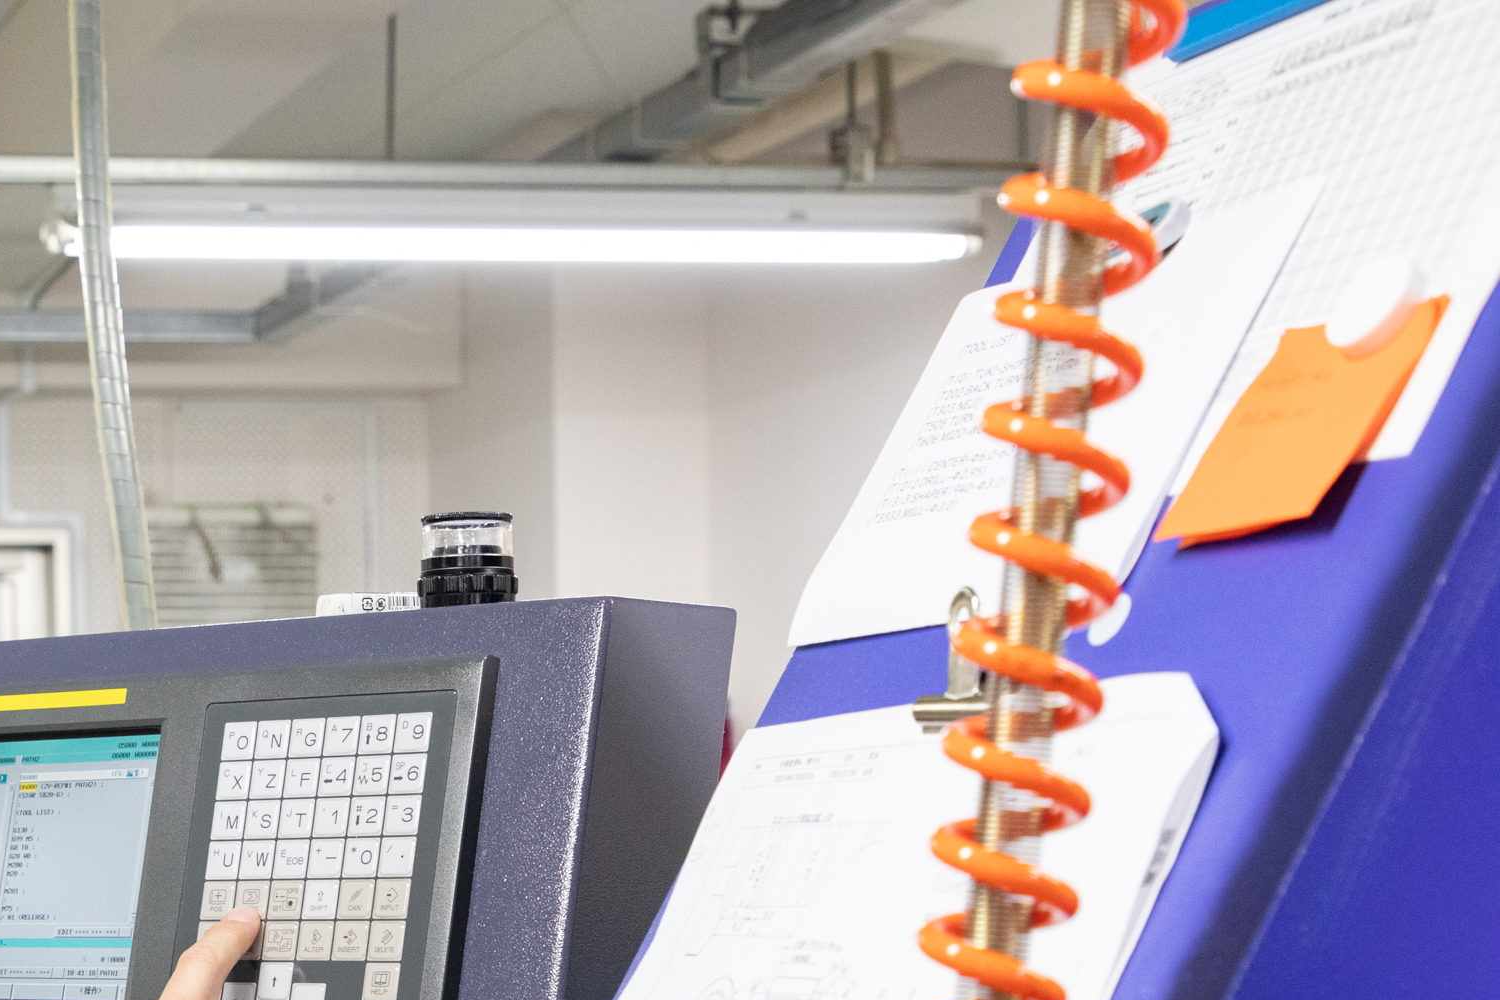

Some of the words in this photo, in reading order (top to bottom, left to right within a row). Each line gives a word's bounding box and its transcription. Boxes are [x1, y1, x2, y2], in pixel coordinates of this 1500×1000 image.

[342, 728, 353, 742] 7
[376, 727, 388, 741] 8
[412, 725, 423, 739] 9
[271, 734, 282, 748] N
[305, 733, 316, 746] G
[300, 773, 311, 787] F
[336, 769, 346, 783] 4
[371, 767, 383, 782] 5
[407, 766, 419, 780] 6
[232, 776, 242, 789] X
[266, 774, 276, 788] Z
[260, 814, 271, 828] S
[296, 813, 306, 827] T
[332, 810, 338, 824] 1
[366, 809, 378, 823] 2
[402, 807, 413, 822] 3
[226, 816, 238, 829] M
[223, 853, 234, 867] U
[256, 853, 269, 866] W
[287, 857, 303, 865] EOB
